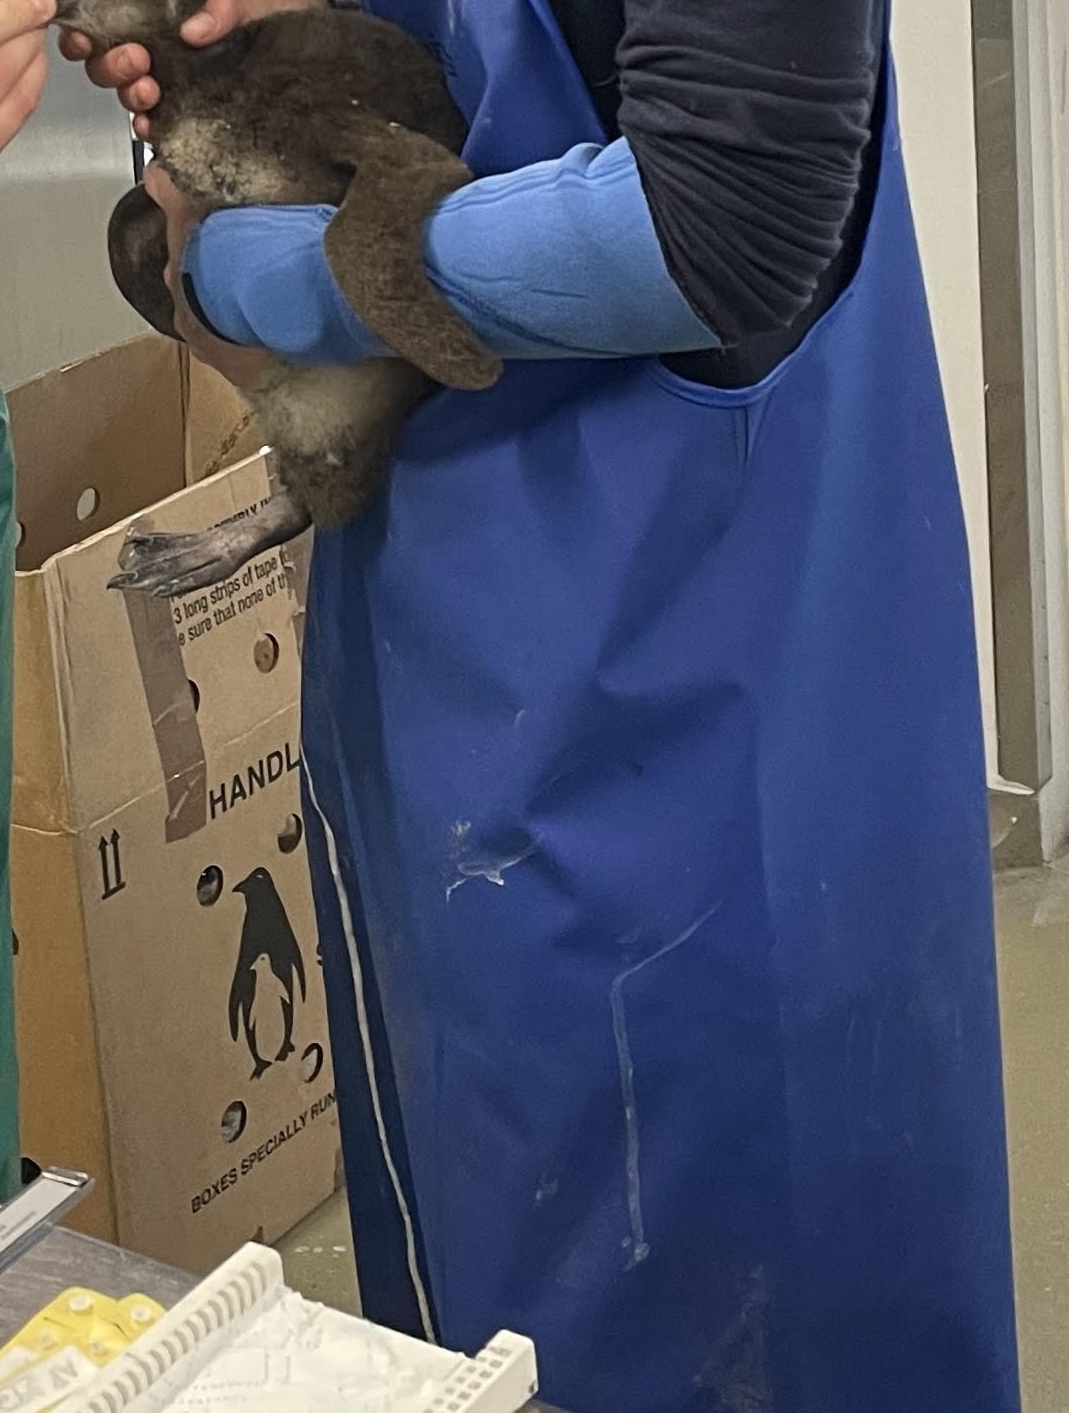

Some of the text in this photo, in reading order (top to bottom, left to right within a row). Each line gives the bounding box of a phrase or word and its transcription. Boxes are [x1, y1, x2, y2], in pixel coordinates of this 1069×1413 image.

[182, 596, 209, 620] long
[210, 577, 241, 605] strips
[242, 566, 255, 587] of
[255, 556, 278, 580] tape
[187, 617, 213, 641] sure
[213, 602, 237, 626] that
[238, 588, 264, 613] none
[266, 578, 277, 597] of
[209, 742, 301, 820] HANDL
[191, 1168, 238, 1214] BOXES
[240, 1110, 308, 1176] SPECIALLY
